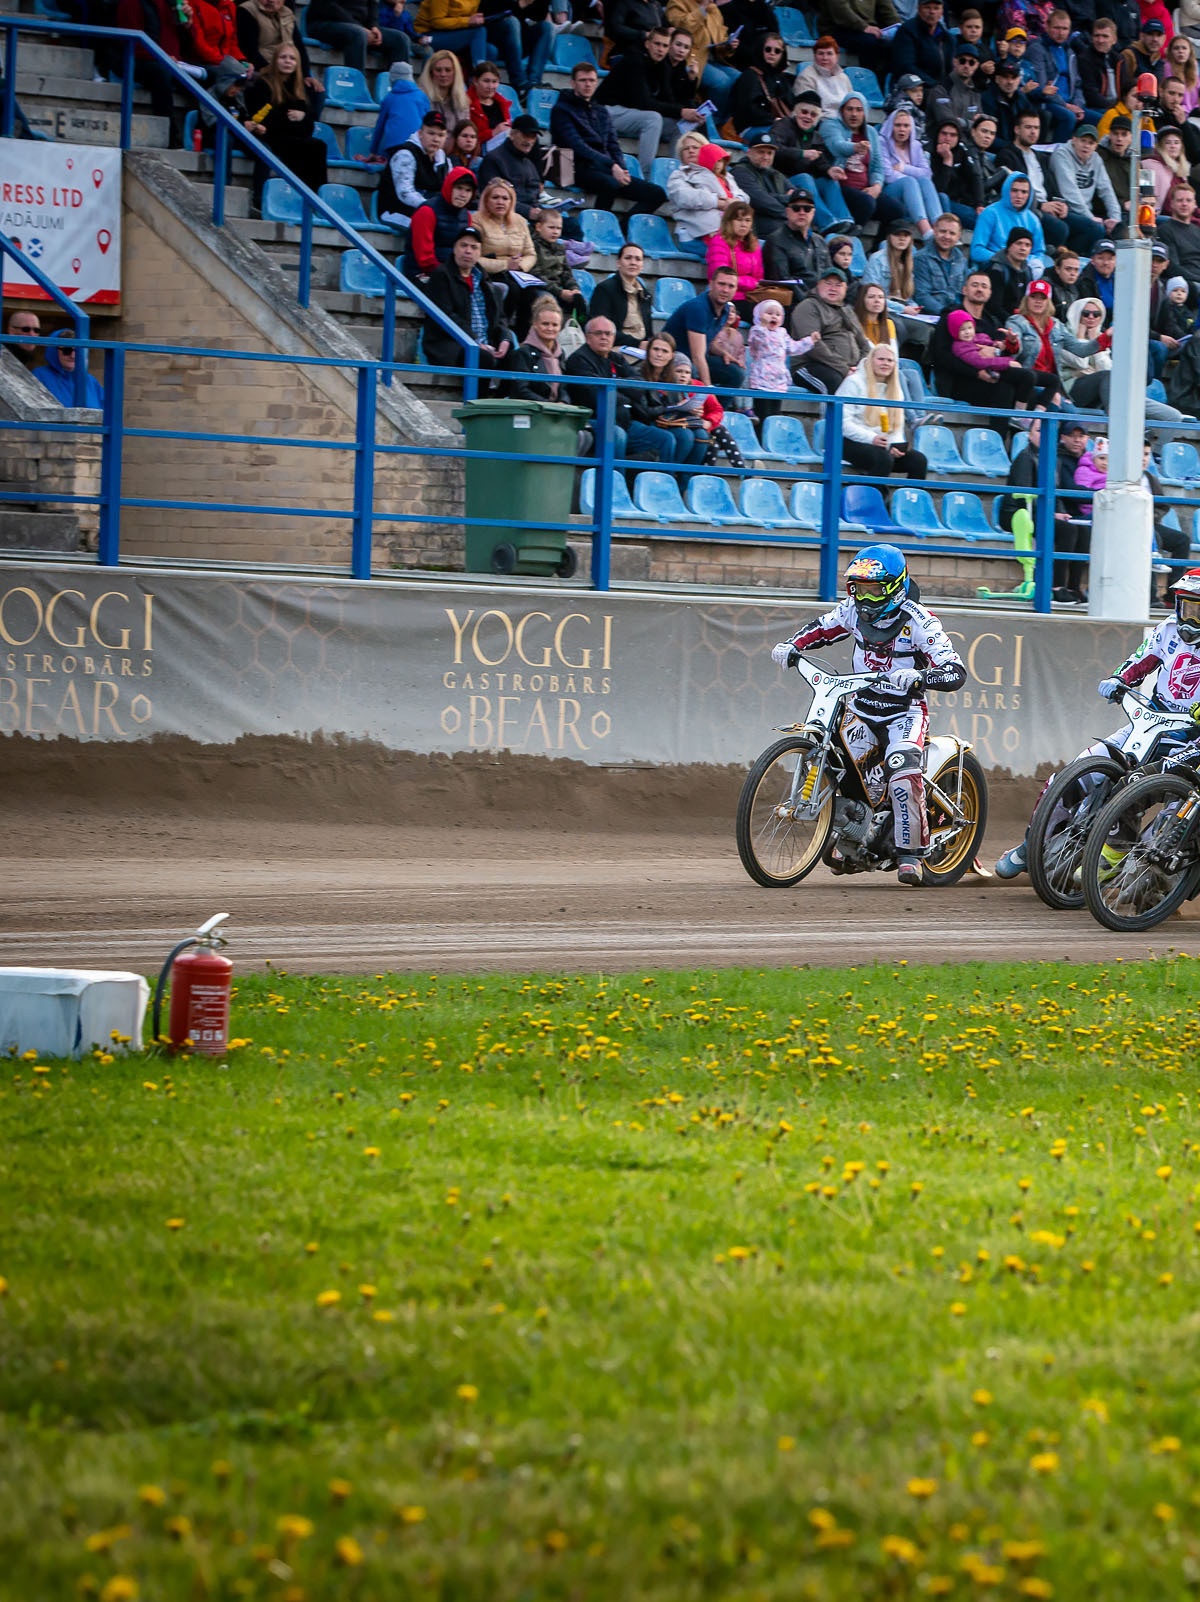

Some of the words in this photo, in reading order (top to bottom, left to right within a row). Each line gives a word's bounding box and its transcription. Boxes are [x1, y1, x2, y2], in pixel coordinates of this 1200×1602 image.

[0, 182, 45, 205] RESS
[53, 187, 84, 208] LTD
[443, 608, 615, 670] YOGGI
[442, 671, 613, 695] GASTROBĀRS
[823, 676, 854, 690] OPTIBET
[468, 694, 592, 750] BEAR
